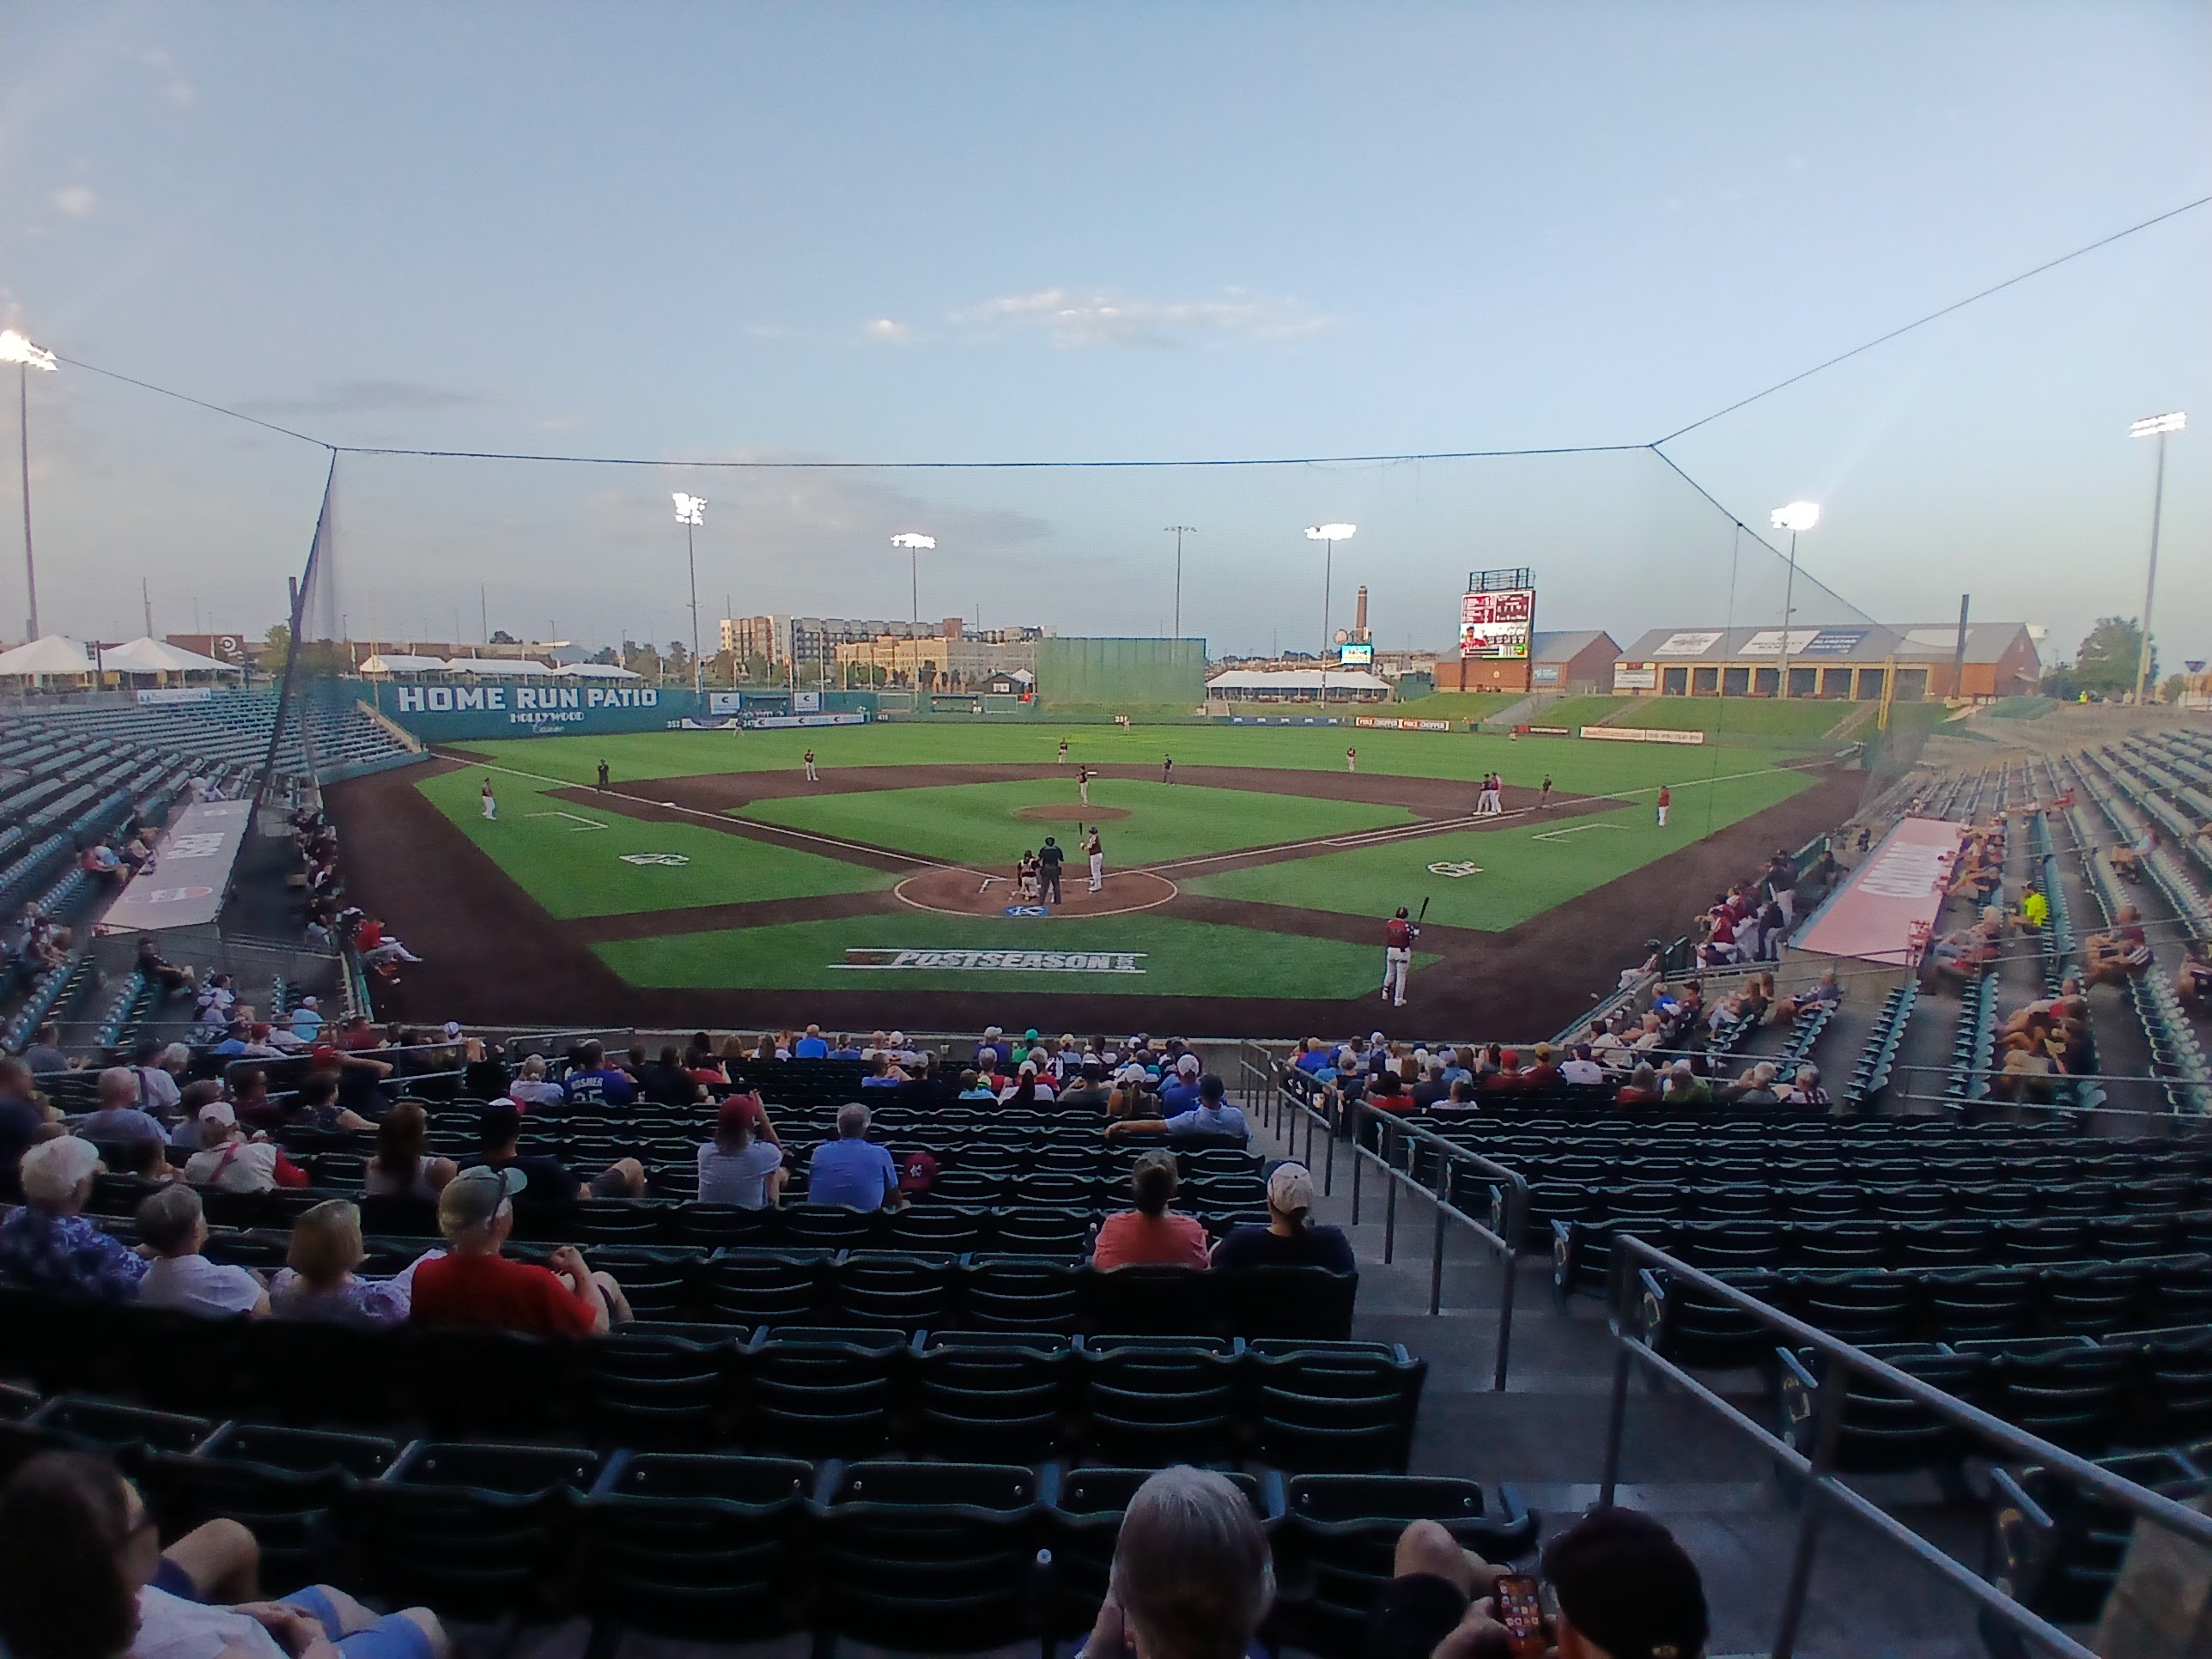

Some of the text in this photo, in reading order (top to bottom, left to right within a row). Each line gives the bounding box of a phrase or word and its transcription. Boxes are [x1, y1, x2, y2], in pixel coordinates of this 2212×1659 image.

[398, 687, 658, 712] HOME RUN PATIO
[510, 711, 584, 723] HOLLYWOOD
[890, 951, 1110, 969] POSTSEASON
